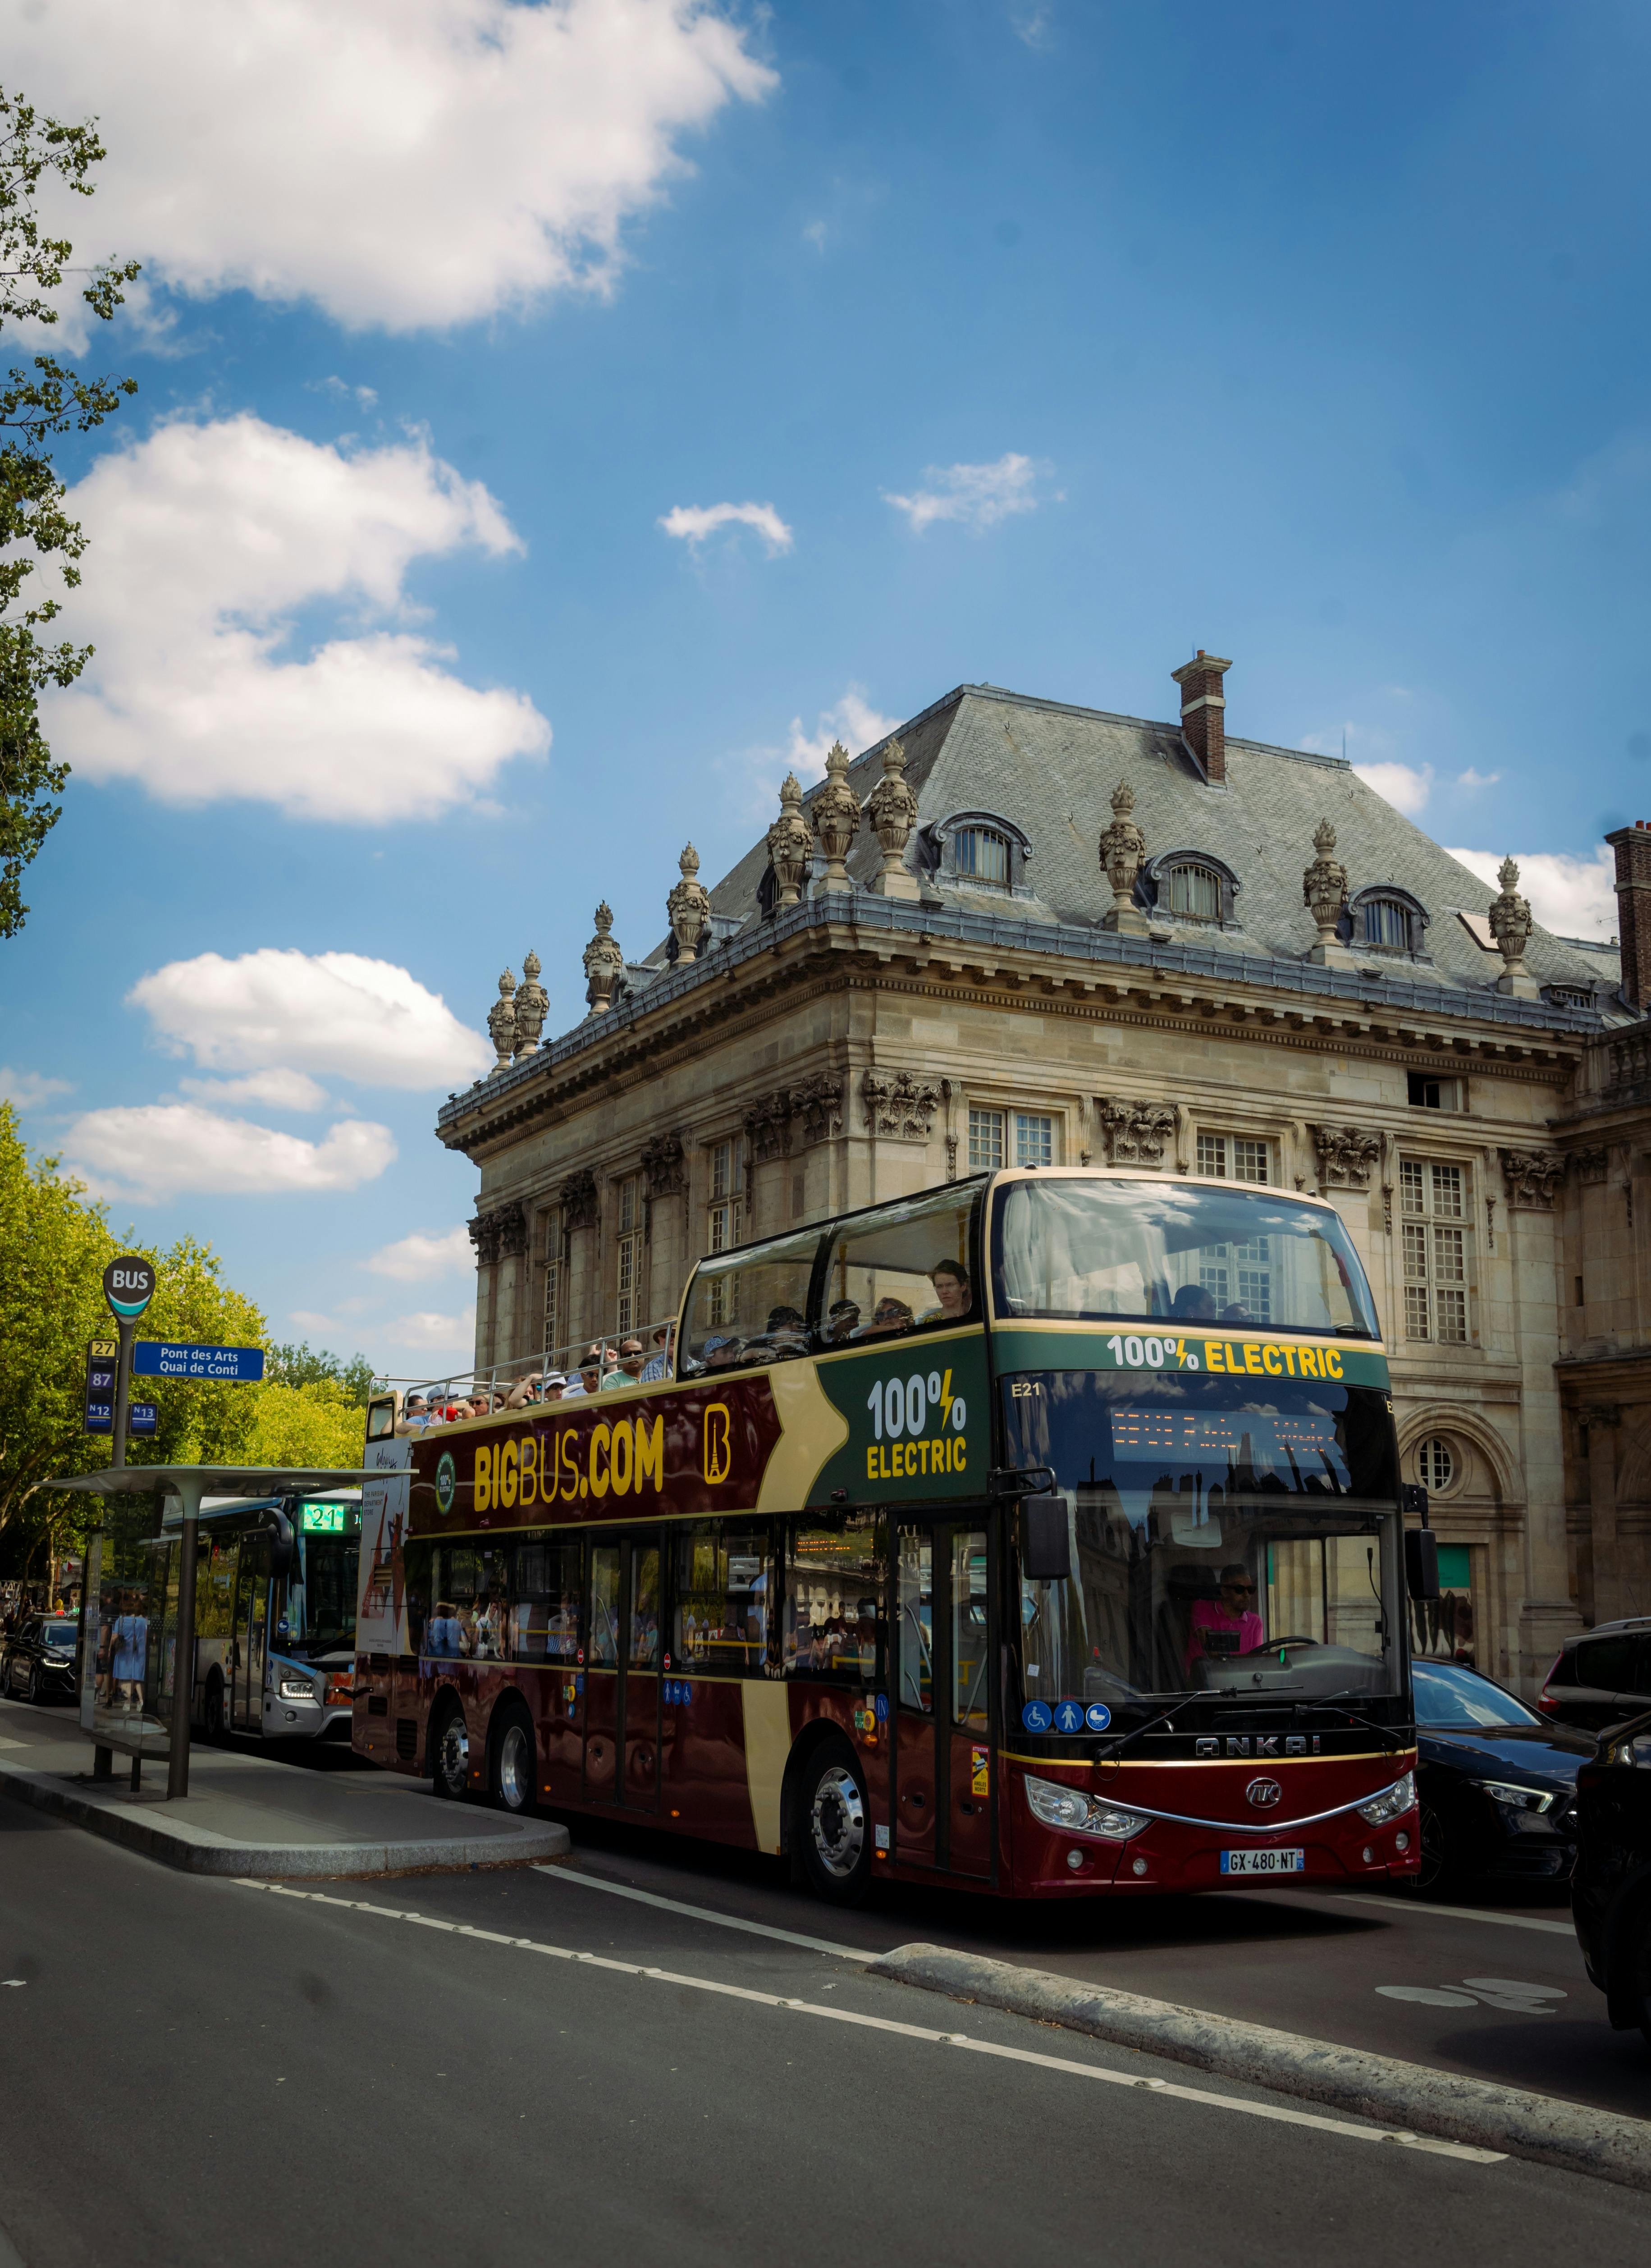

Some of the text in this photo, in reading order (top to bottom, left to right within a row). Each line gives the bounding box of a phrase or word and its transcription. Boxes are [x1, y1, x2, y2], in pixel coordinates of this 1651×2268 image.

[112, 1270, 148, 1290] BUS
[95, 1342, 112, 1355] 27
[160, 1347, 238, 1362] Pont des Arts
[1107, 1335, 1344, 1379] 100% ELECTRIC
[160, 1361, 238, 1375] Quai de Conti
[93, 1373, 111, 1386] 87
[1011, 1383, 1039, 1397] E21
[867, 1369, 966, 1440] 100%
[474, 1414, 663, 1512] BIGBUS.COM
[867, 1436, 966, 1479] ELECTRIC
[439, 1474, 451, 1486] 100%
[312, 1508, 335, 1527] 21
[878, 1700, 886, 1716] IN
[1196, 1736, 1321, 1756] ANKAI
[1230, 1851, 1295, 1870] GX-480-NT
[1297, 1860, 1303, 1868] 75
